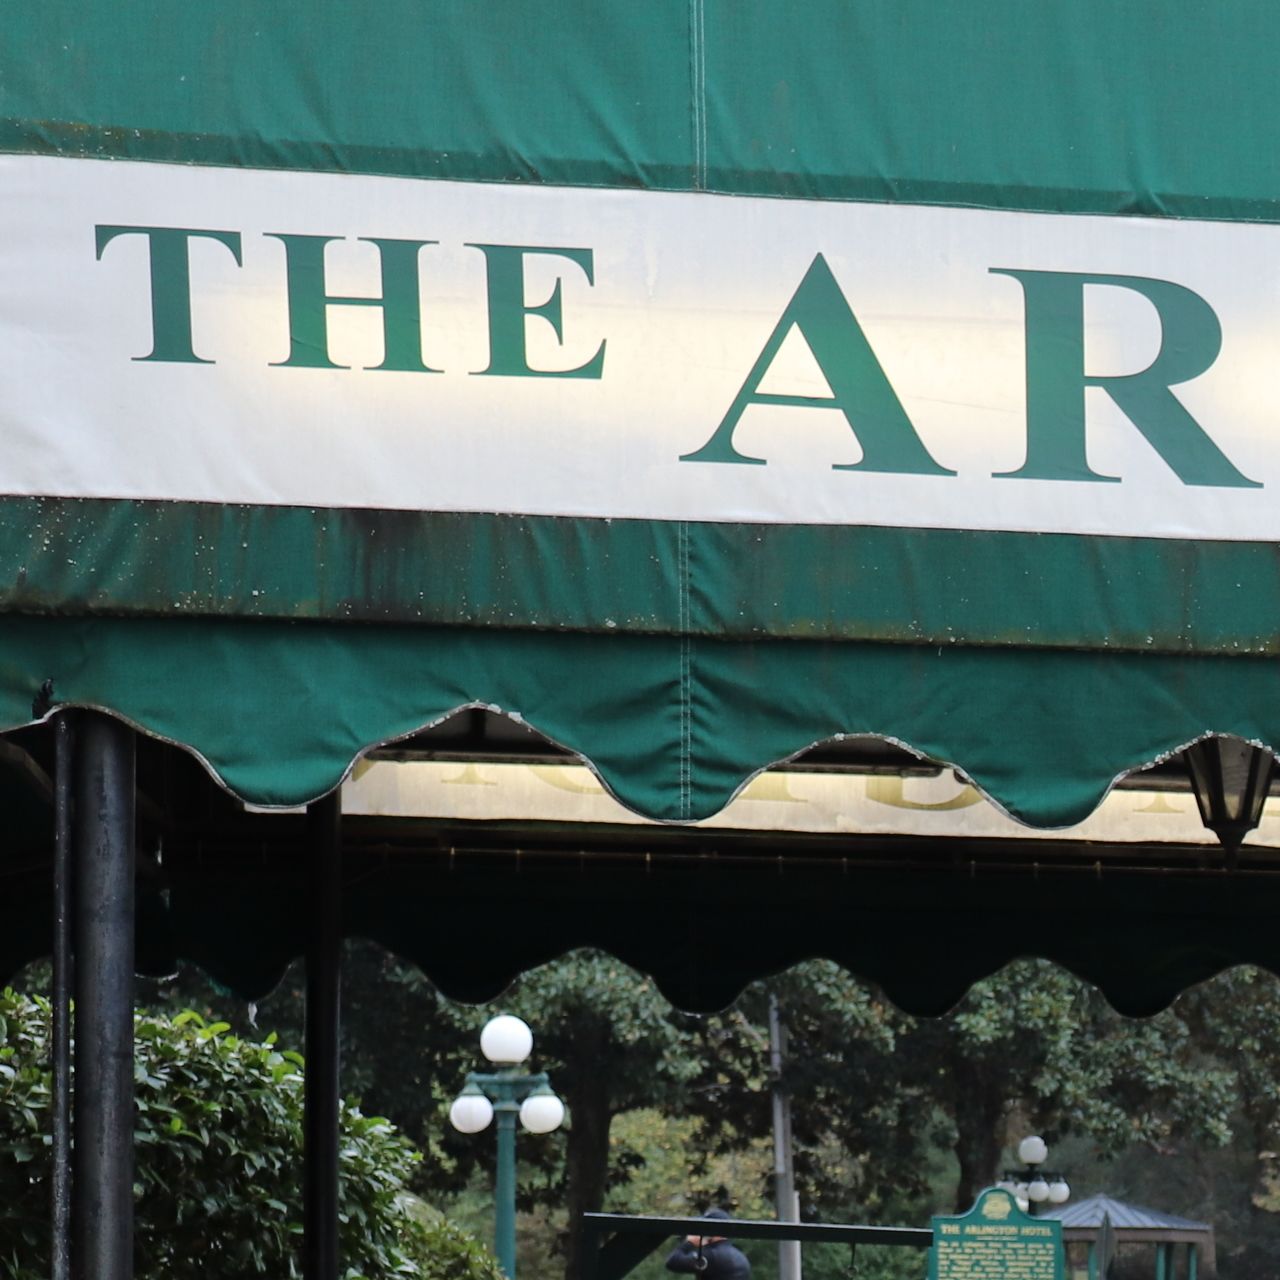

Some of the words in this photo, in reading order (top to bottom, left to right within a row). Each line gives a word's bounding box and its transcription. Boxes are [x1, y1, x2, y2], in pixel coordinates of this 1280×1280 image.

[94, 223, 608, 381] THE
[941, 1223, 961, 1235] THE
[964, 1224, 1019, 1236] ARLINGTON
[1020, 1226, 1053, 1237] HOTEL
